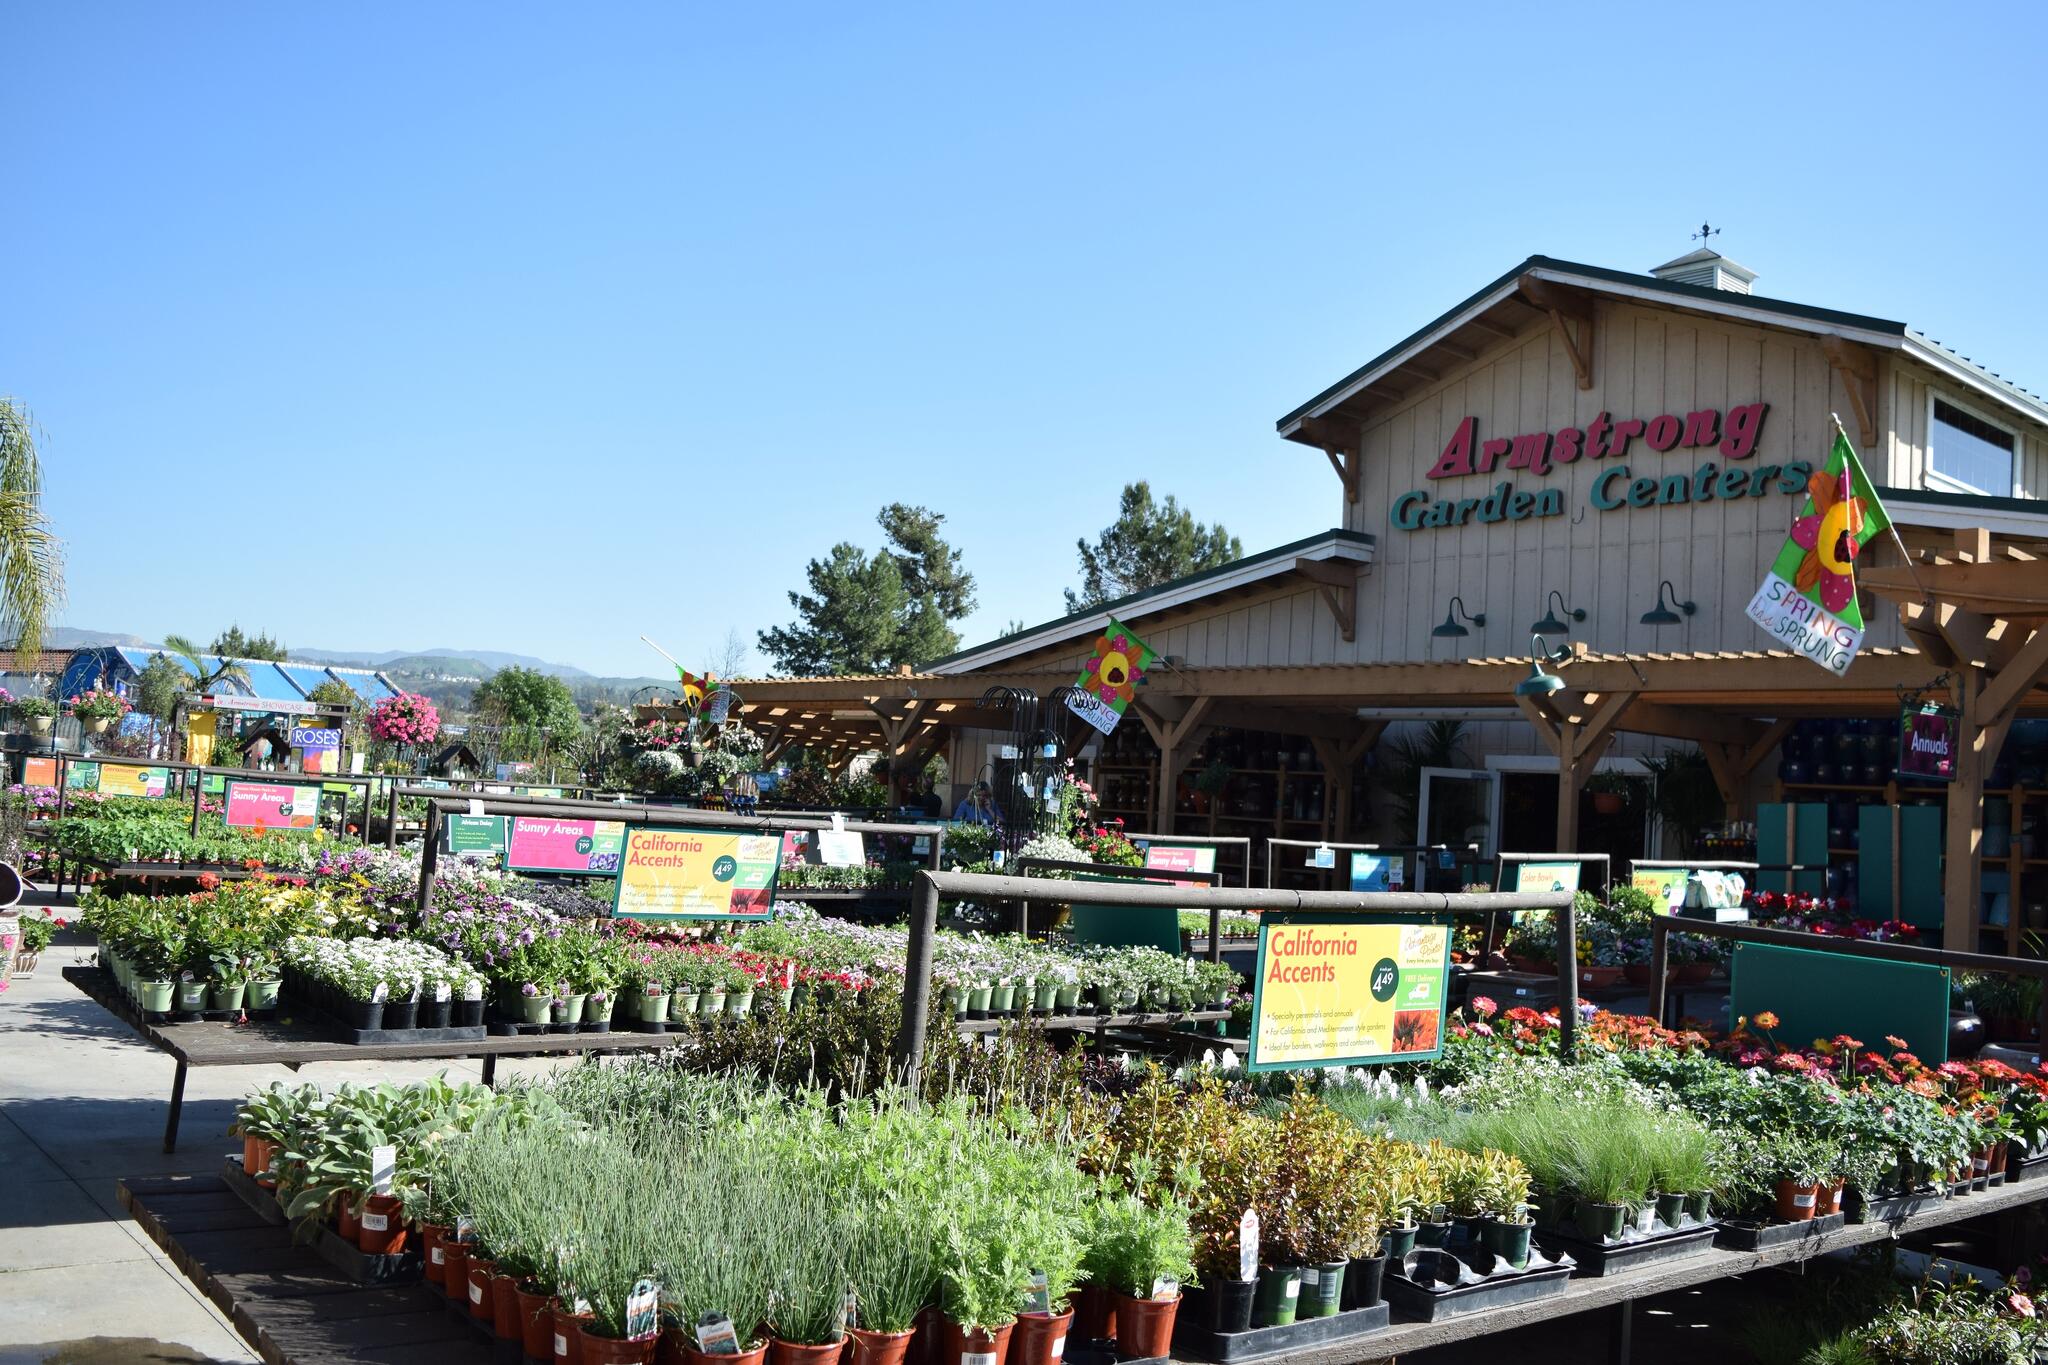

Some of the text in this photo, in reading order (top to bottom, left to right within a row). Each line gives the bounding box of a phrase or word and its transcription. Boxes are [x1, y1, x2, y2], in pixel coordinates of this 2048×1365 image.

[1426, 403, 1769, 479] Armstrong
[1390, 461, 1812, 531] Garden Centers
[1767, 581, 1858, 648] SPRING
[1751, 596, 1850, 671] has SPRUNG
[261, 701, 303, 711] SHOWCASE
[295, 730, 339, 745] ROSES
[1911, 731, 1949, 756] Annuals
[232, 791, 285, 803] Sunny Areas
[517, 821, 583, 836] Sunny Areas
[631, 834, 703, 852] California
[628, 850, 684, 868] Accents
[1150, 855, 1169, 868] Sunny
[1521, 871, 1536, 882] Color
[1271, 929, 1358, 956] California
[1267, 959, 1336, 984] Accents
[1271, 1012, 1295, 1022] Specialty
[1323, 1009, 1334, 1017] and
[1270, 1028, 1279, 1036] For
[1280, 1027, 1306, 1036] California
[1307, 1026, 1317, 1034] and
[1366, 1023, 1386, 1032] gardens
[1268, 1043, 1282, 1052] Ideal
[1283, 1043, 1291, 1051] for
